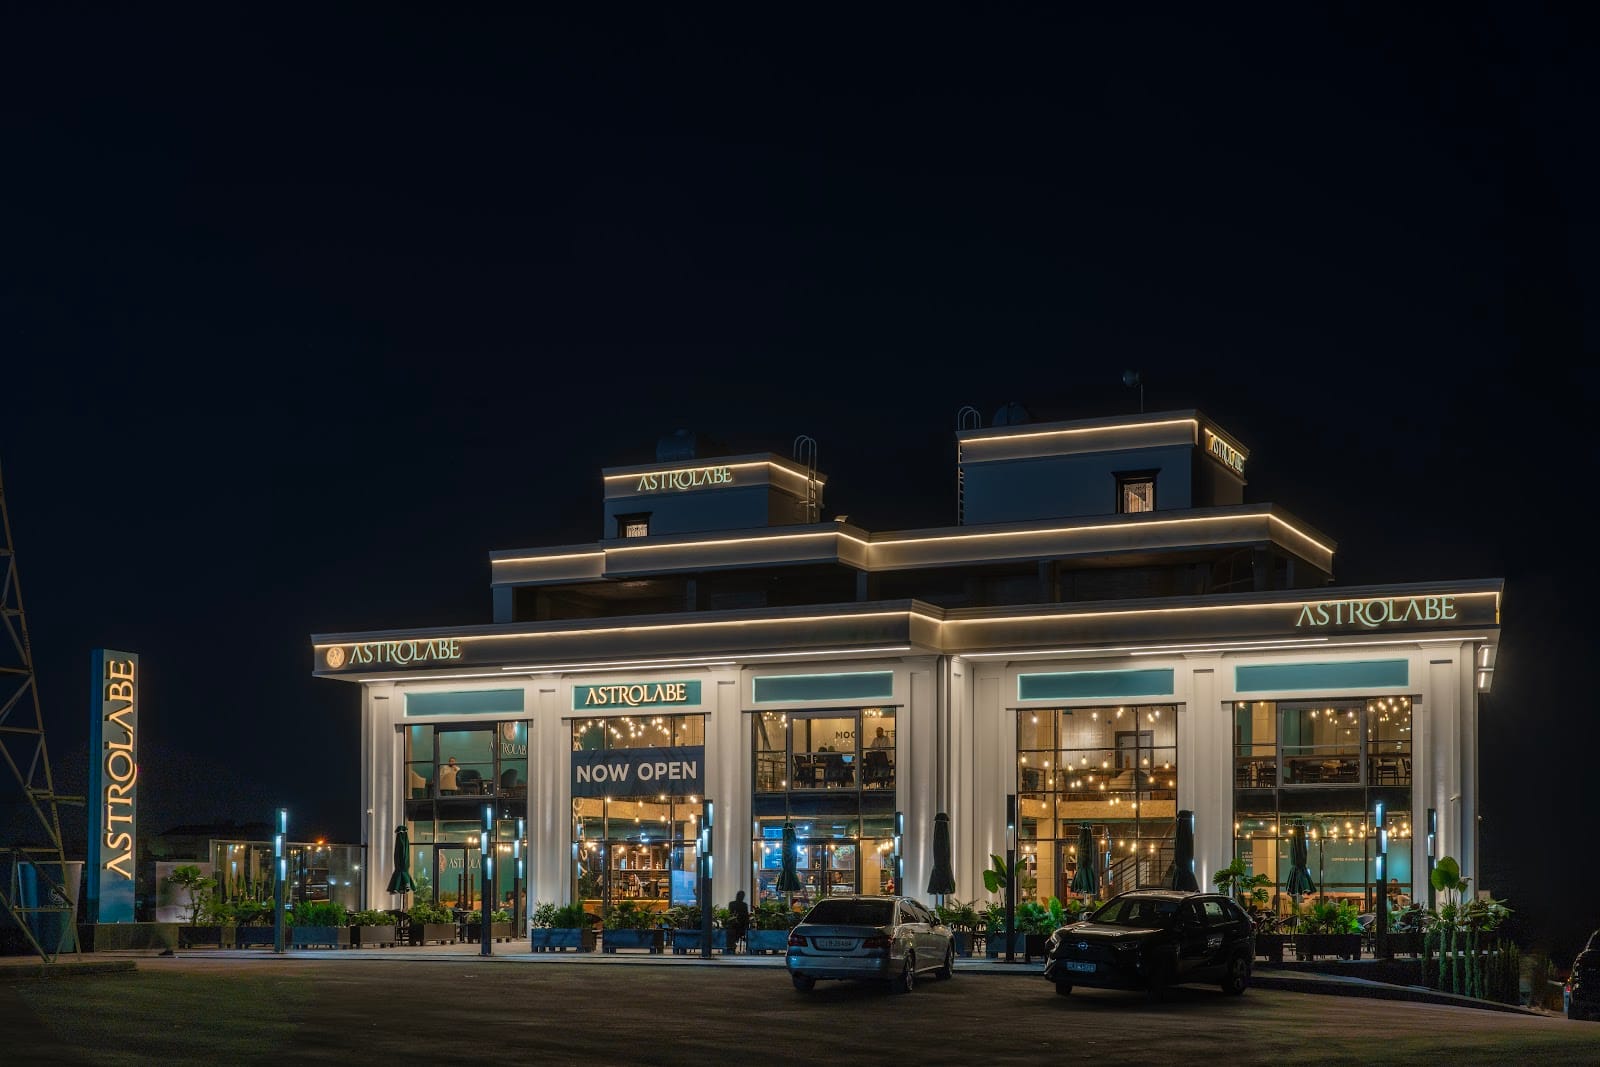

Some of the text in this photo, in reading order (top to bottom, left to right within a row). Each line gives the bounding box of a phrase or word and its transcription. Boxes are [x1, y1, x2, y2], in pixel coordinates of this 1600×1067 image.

[636, 466, 733, 492] ASTROLABE
[1295, 595, 1458, 628] ASTROLABE
[348, 639, 463, 665] ASTROLABE
[585, 682, 688, 706] ASTROLABE
[105, 659, 138, 880] ASTROLABE
[576, 760, 697, 784] NOW OPEN
